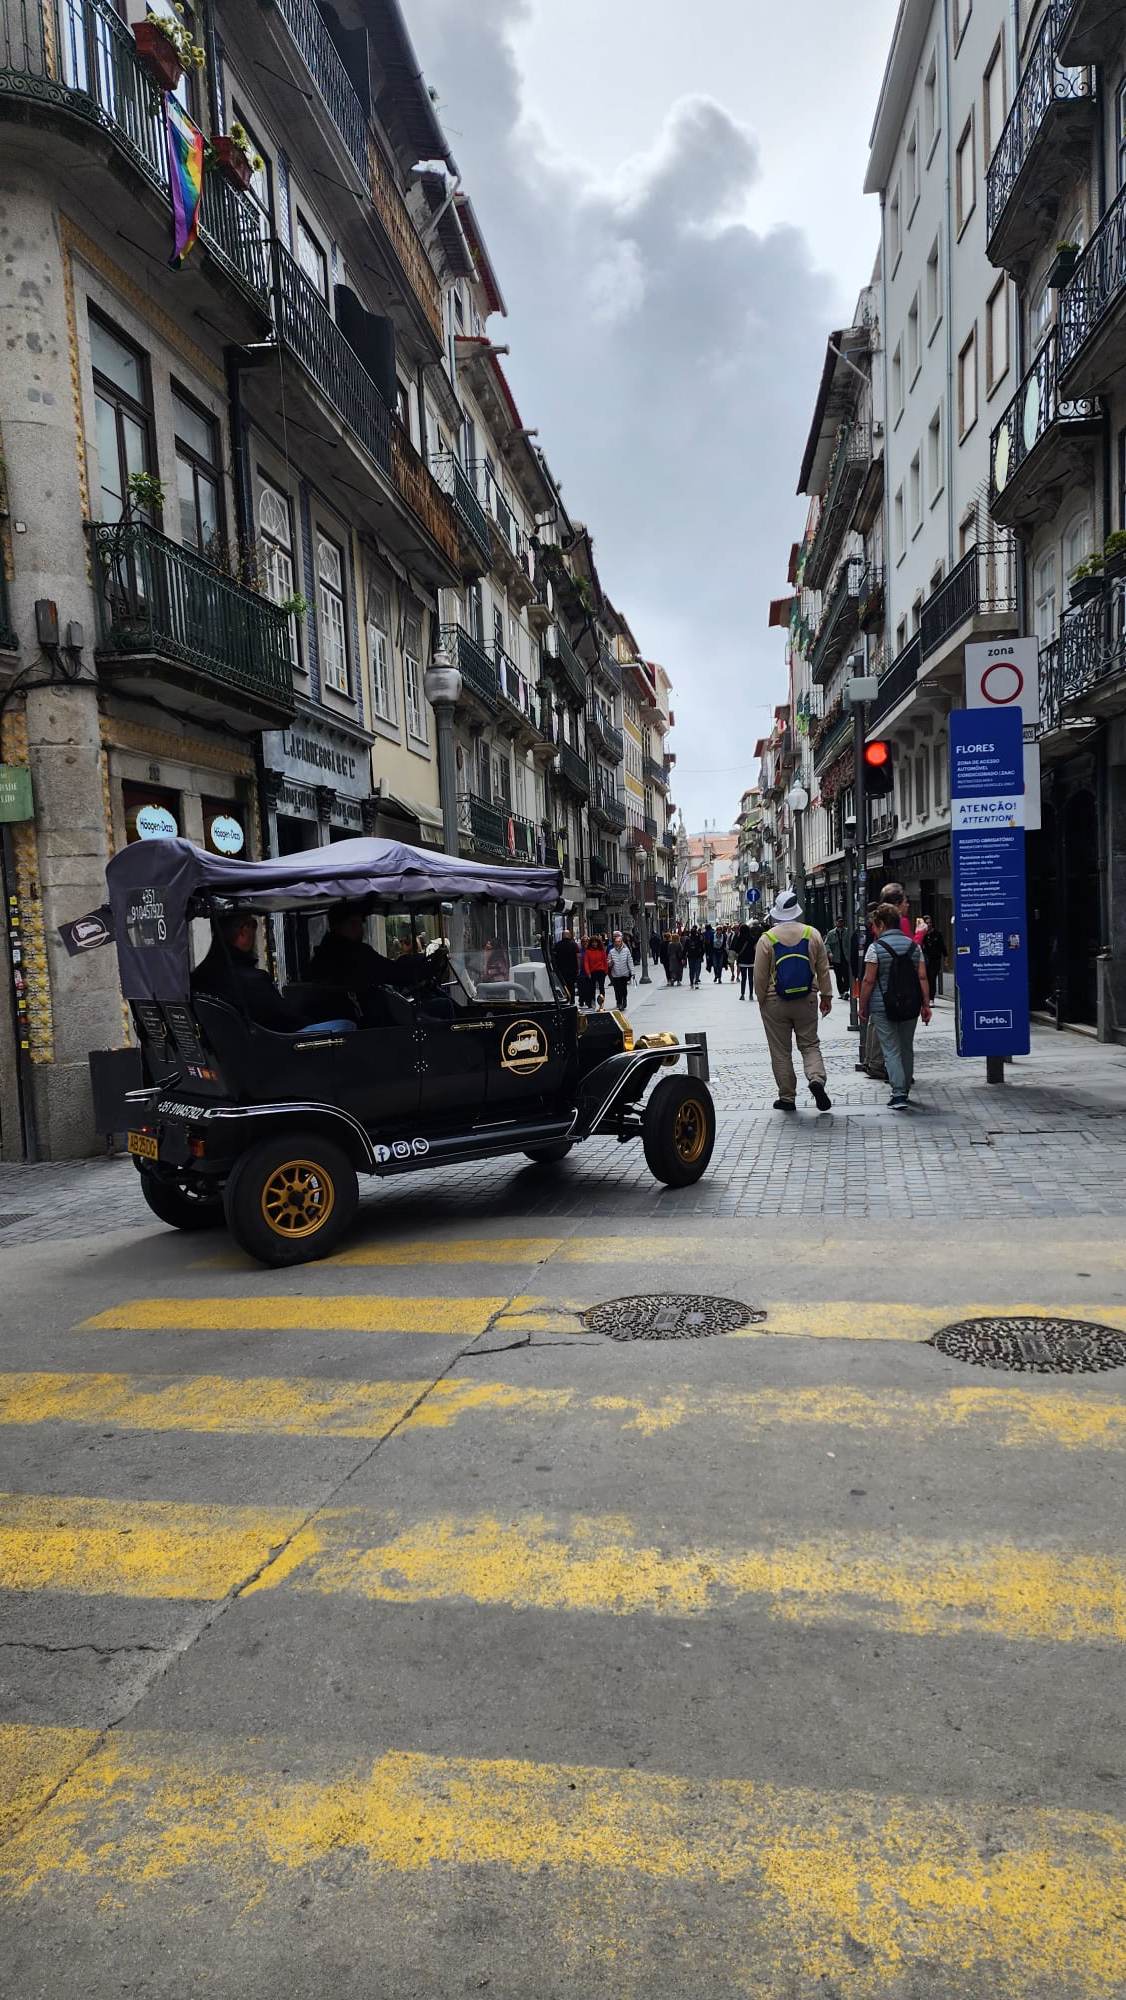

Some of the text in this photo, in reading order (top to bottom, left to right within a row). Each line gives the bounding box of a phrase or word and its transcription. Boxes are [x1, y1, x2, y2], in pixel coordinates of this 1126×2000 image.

[988, 647, 1014, 656] zona
[956, 744, 995, 754] FLORES
[960, 801, 1017, 813] ATENÇÃO!
[962, 814, 1014, 824] ATTENTION!
[142, 889, 156, 904] +351
[131, 902, 165, 921] 910457922
[979, 1015, 1008, 1025] Porto.
